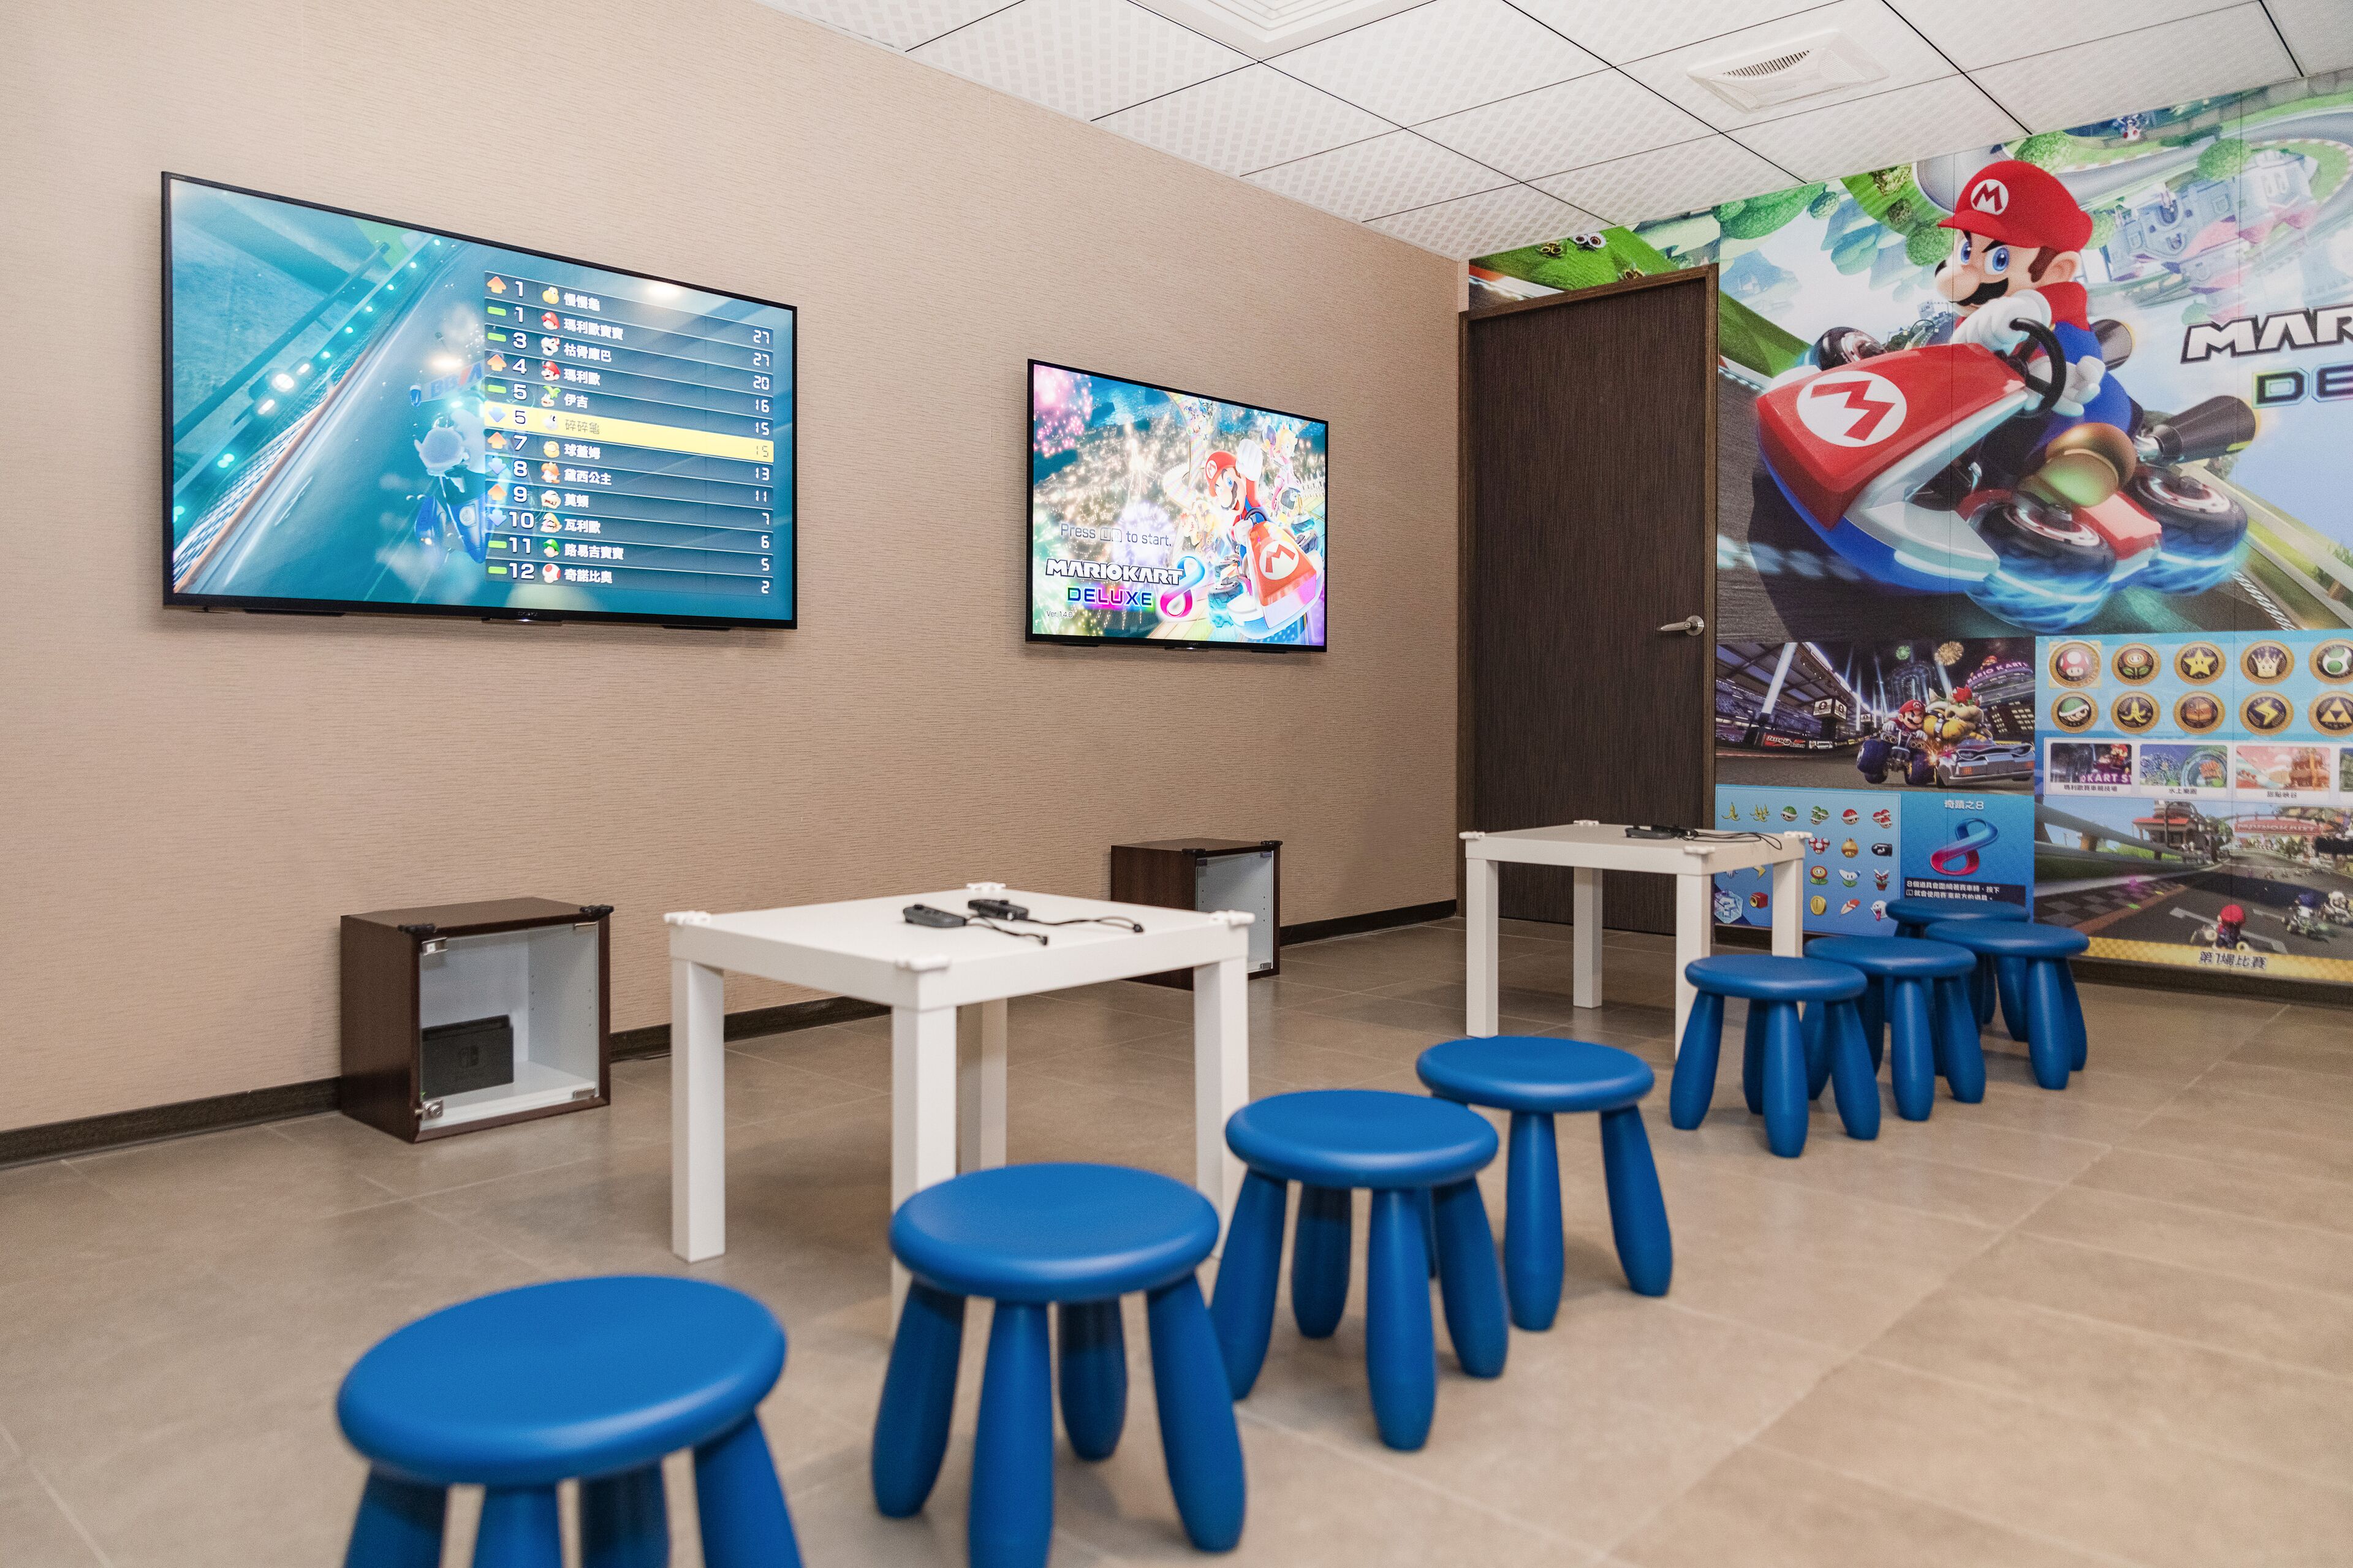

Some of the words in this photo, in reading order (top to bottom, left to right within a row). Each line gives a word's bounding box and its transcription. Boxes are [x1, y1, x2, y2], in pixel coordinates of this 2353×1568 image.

[515, 281, 523, 297] 1
[753, 330, 770, 344] 27
[515, 306, 523, 323] 1
[753, 352, 770, 367] 27
[513, 332, 527, 349] 3
[564, 343, 612, 363] 枯骨庫巴
[753, 375, 770, 390] 20
[512, 358, 527, 374] 4
[564, 368, 601, 386] 瑪利歐
[756, 399, 770, 413] 16
[513, 384, 527, 400] 5
[564, 393, 588, 409] 伊吉
[756, 422, 770, 436] 15
[515, 410, 526, 425] 5
[565, 419, 600, 434] 碎碎龜
[756, 445, 768, 458] 15
[513, 435, 528, 450] 7
[756, 468, 770, 481] 13
[513, 461, 528, 477] 8
[756, 490, 767, 502] 11
[513, 487, 528, 502] 9
[762, 512, 770, 525] 7
[509, 512, 535, 529] 10
[564, 518, 601, 534] 瓦利歐
[761, 535, 770, 548] 6
[1061, 523, 1096, 539] Press
[1126, 531, 1138, 543] to
[1142, 533, 1172, 547] start.
[509, 537, 531, 553] 11
[564, 544, 624, 560] 路易吉寶寶
[761, 558, 770, 571] 5
[509, 563, 535, 580] 12
[761, 580, 770, 594] 2
[1067, 586, 1154, 607] DELUXE
[1967, 668, 1994, 684] MARIO
